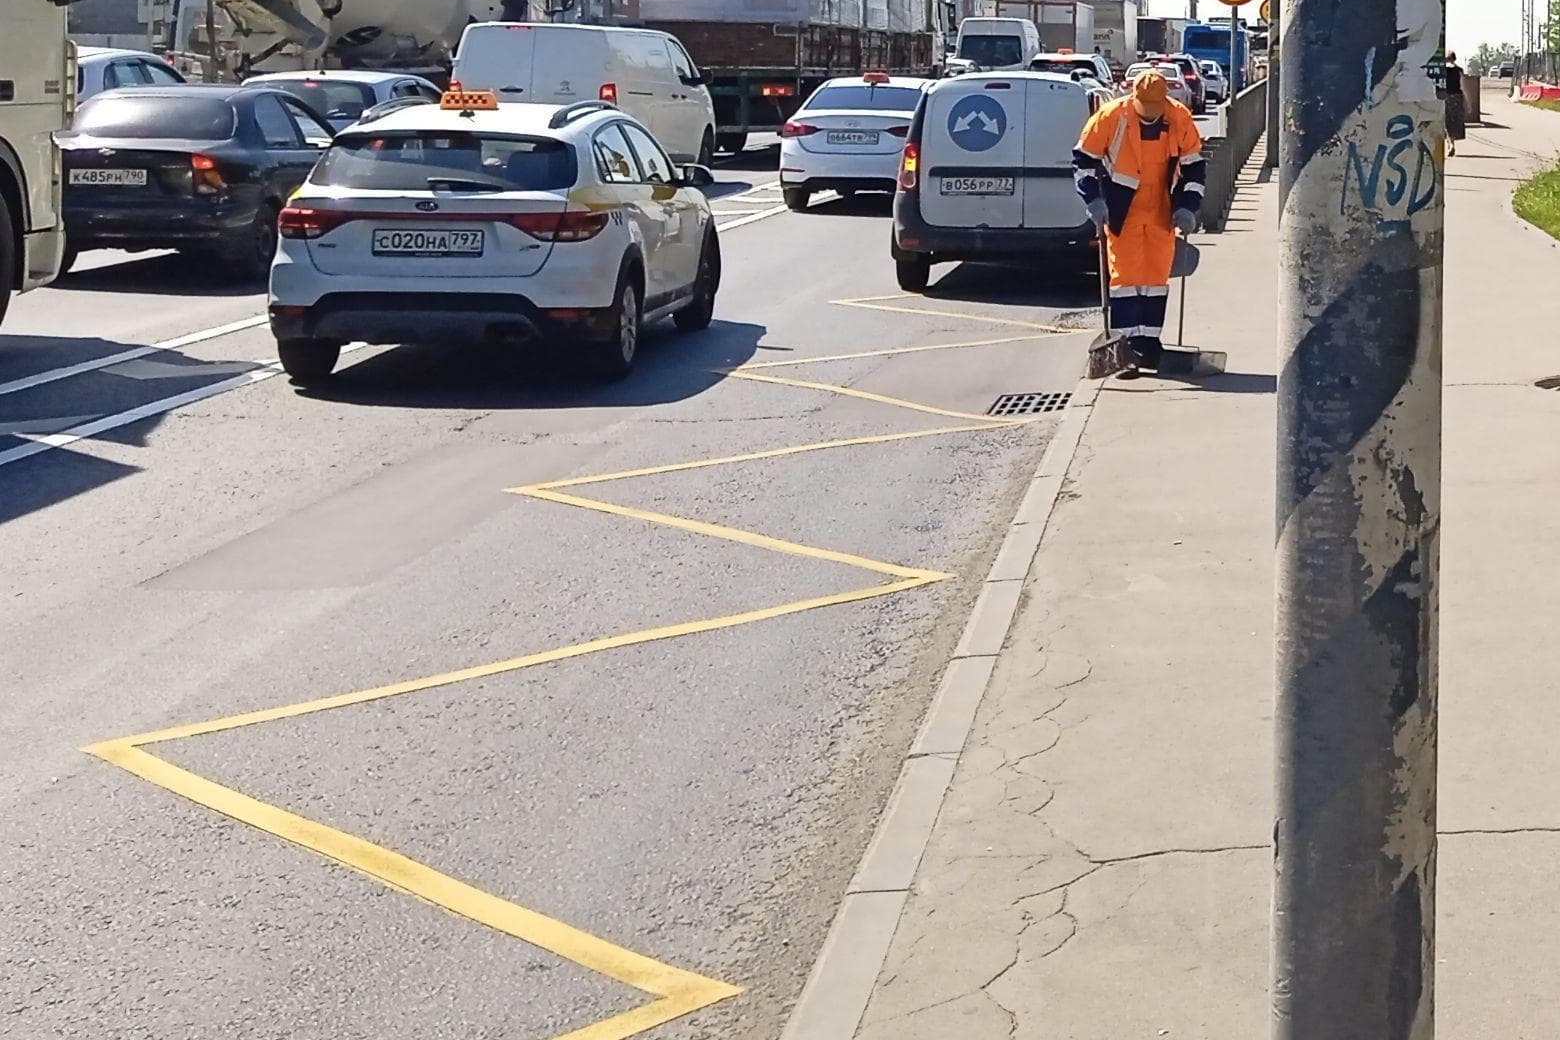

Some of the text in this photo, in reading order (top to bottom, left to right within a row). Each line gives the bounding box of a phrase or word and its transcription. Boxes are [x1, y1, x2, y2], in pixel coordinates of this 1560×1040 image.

[73, 170, 144, 183] К485РН 790
[946, 178, 994, 191] В056РР
[379, 233, 479, 249] С020НА 797
